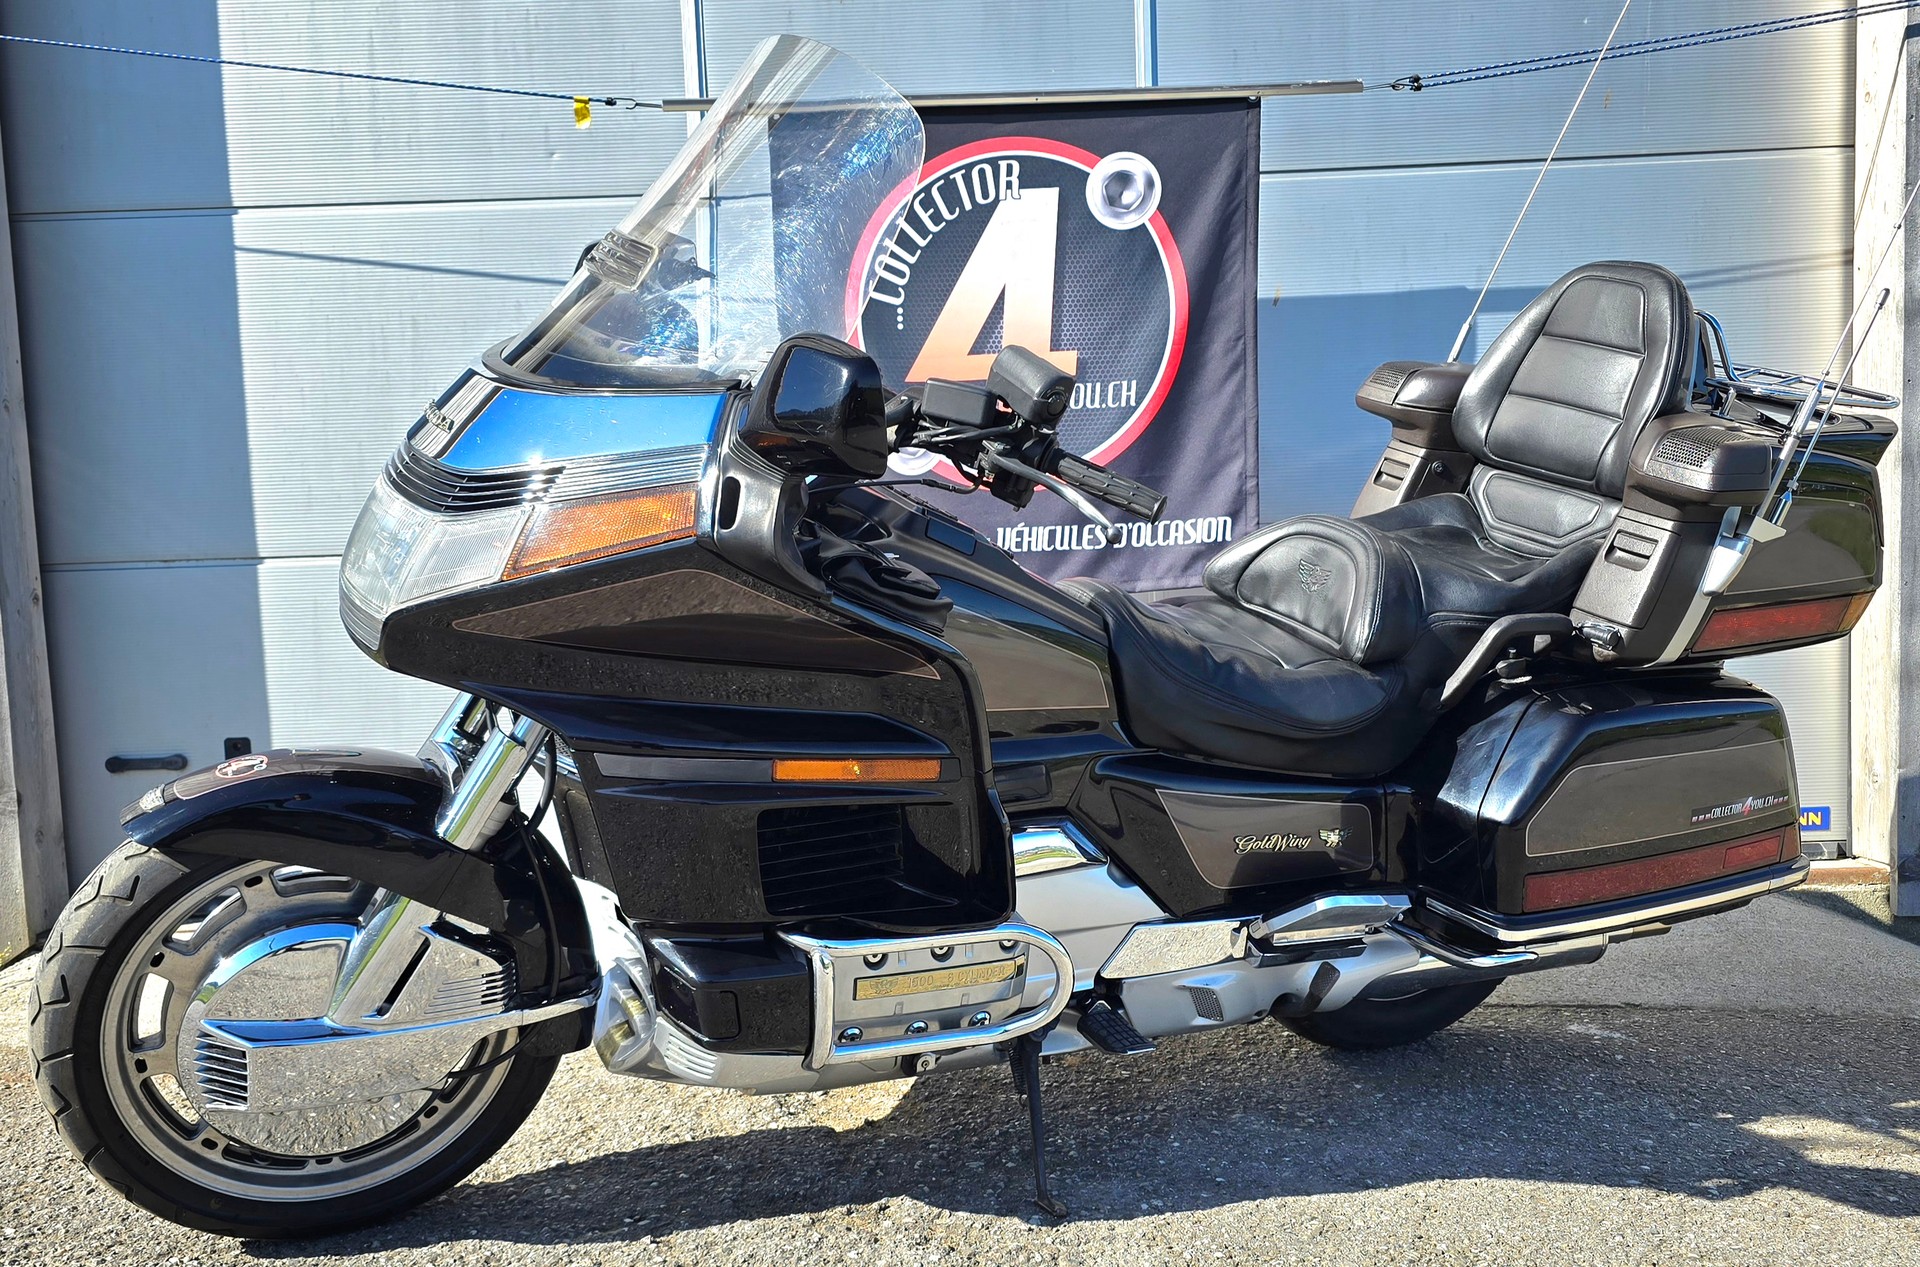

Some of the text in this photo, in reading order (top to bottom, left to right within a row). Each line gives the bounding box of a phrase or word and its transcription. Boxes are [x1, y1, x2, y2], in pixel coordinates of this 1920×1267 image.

[904, 186, 1078, 412] 4
[1069, 379, 1137, 410] OU.CH
[996, 515, 1232, 553] VÉHICULES D'OCCASION
[1235, 833, 1312, 855] GoldWing
[907, 974, 935, 989] 1500
[957, 965, 1006, 981] CYLINDER
